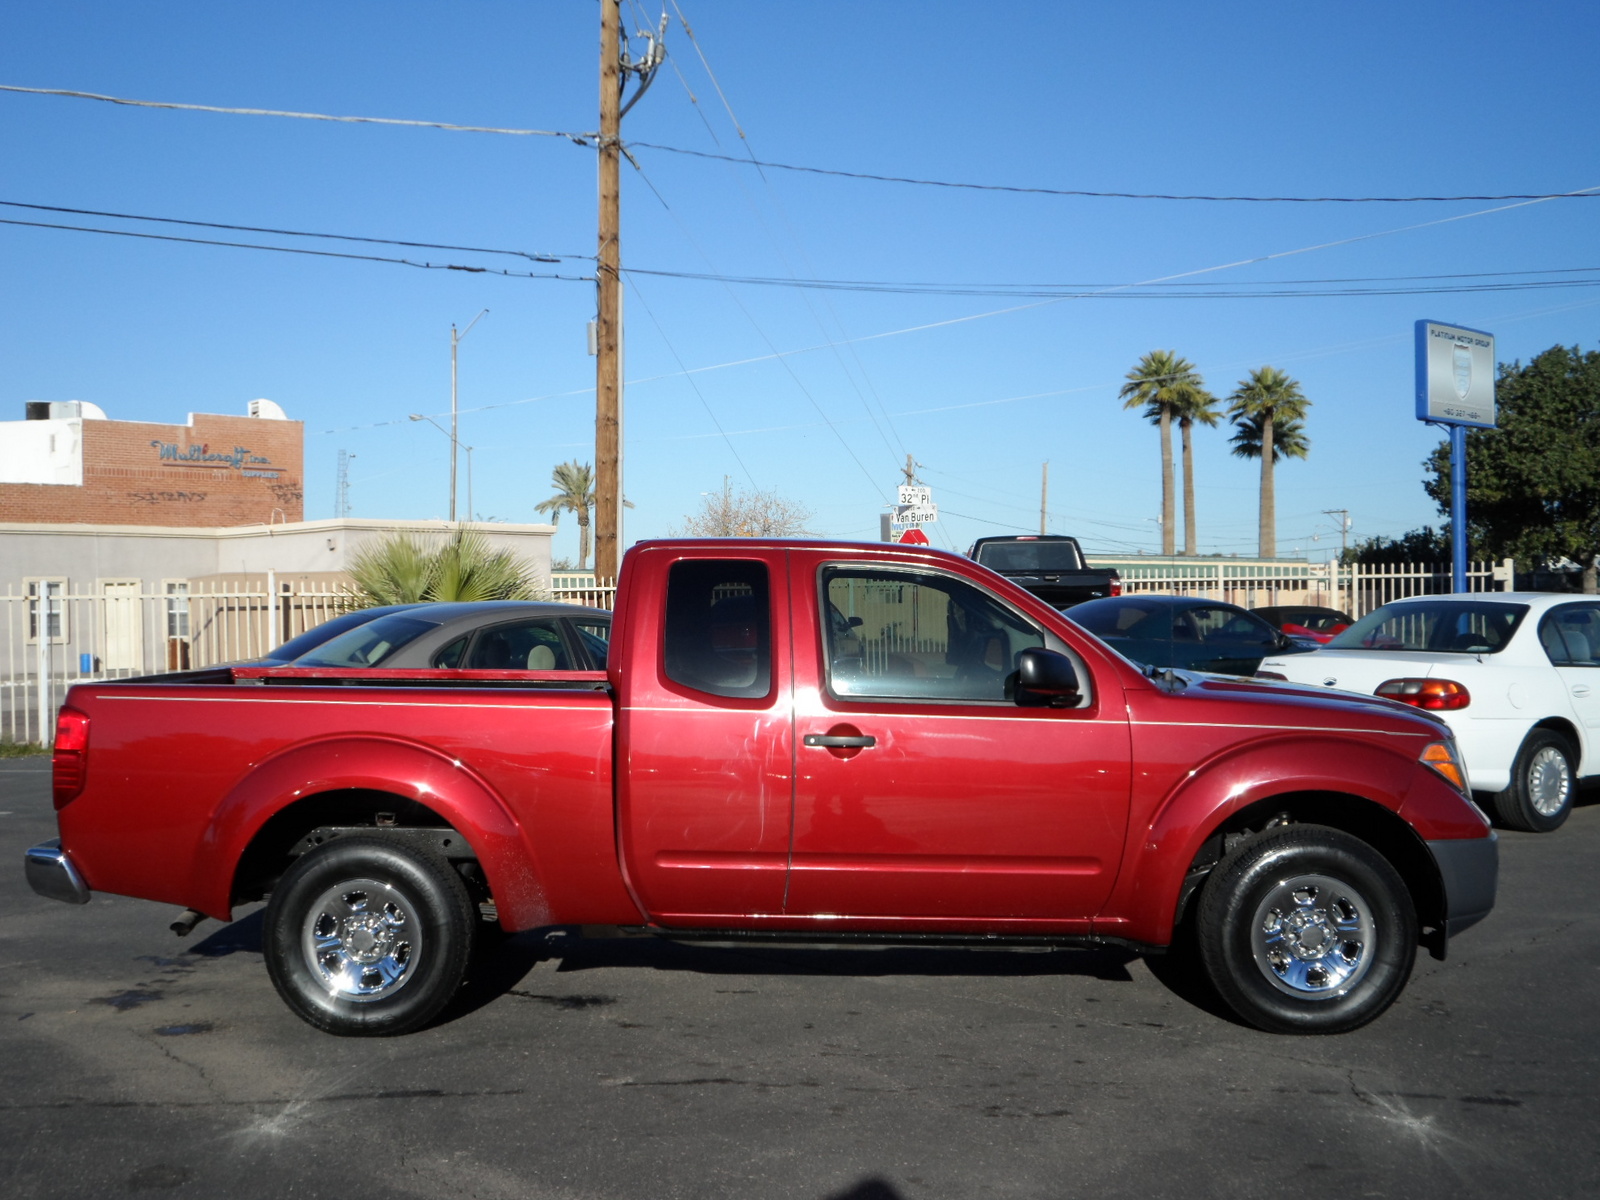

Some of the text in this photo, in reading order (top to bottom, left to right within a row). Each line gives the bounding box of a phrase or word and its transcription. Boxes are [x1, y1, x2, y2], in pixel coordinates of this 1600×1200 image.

[1431, 330, 1490, 348] PLATINUM MOTOR GROUP
[921, 494, 930, 504] Pl
[896, 513, 910, 523] Van
[911, 512, 934, 522] Buren
